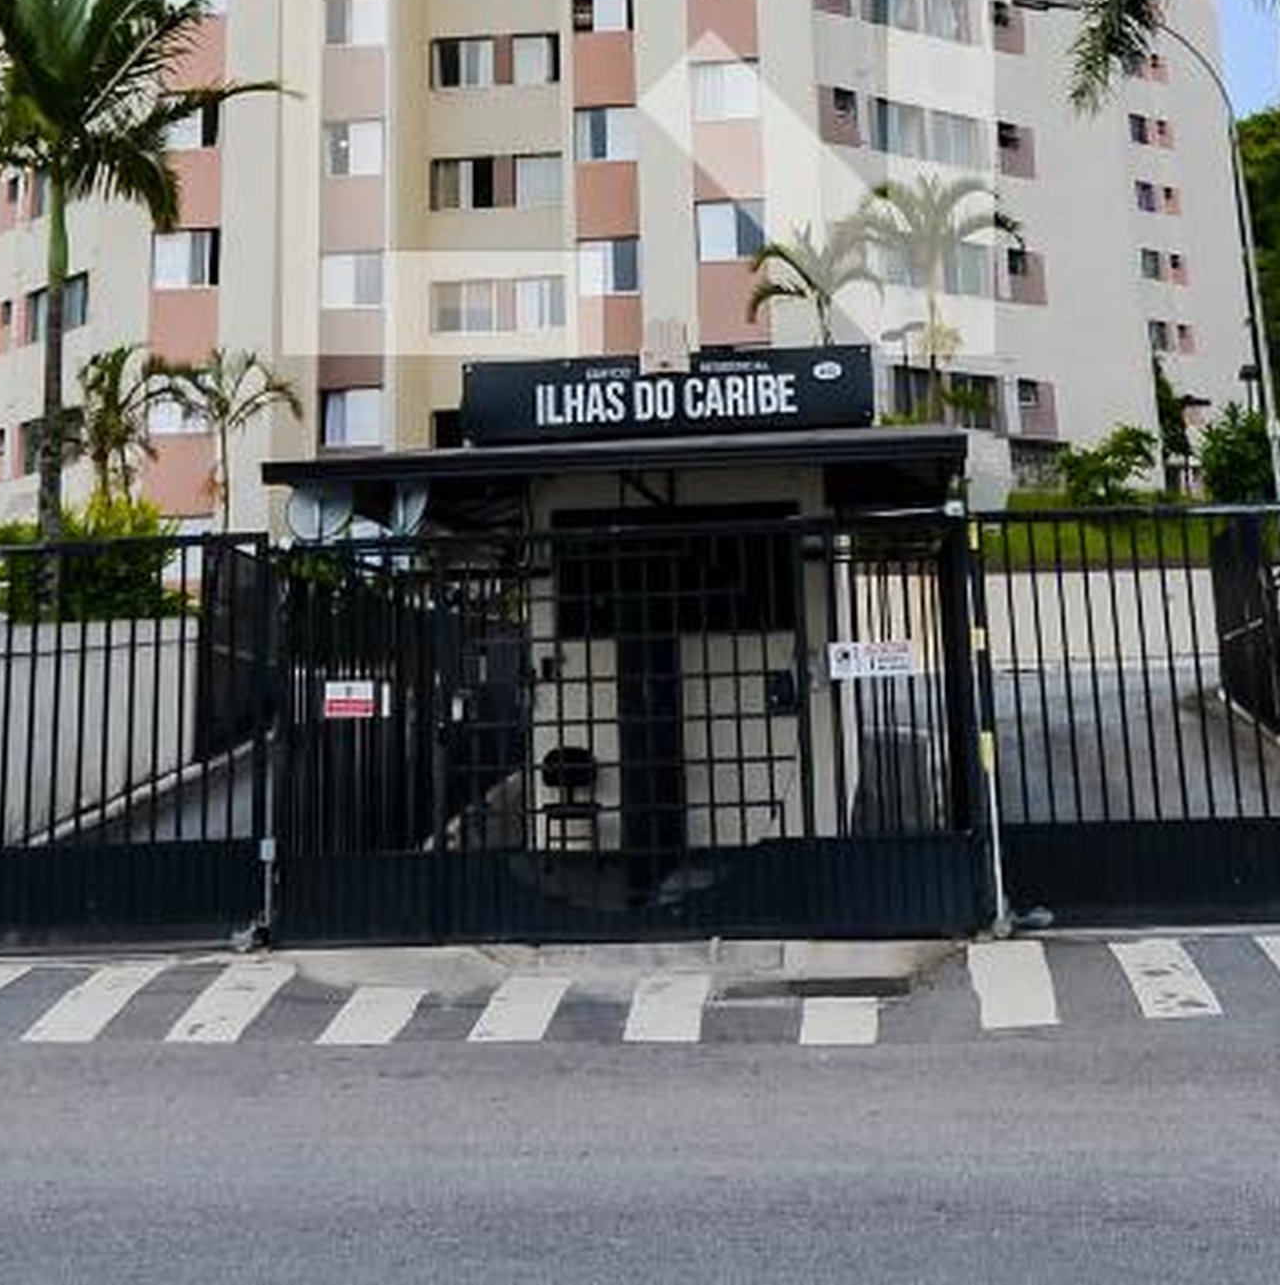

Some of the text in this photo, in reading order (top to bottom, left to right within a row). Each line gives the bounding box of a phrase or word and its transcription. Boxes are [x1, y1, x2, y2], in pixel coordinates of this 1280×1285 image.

[536, 374, 798, 426] ILHAS DO CARIBE
